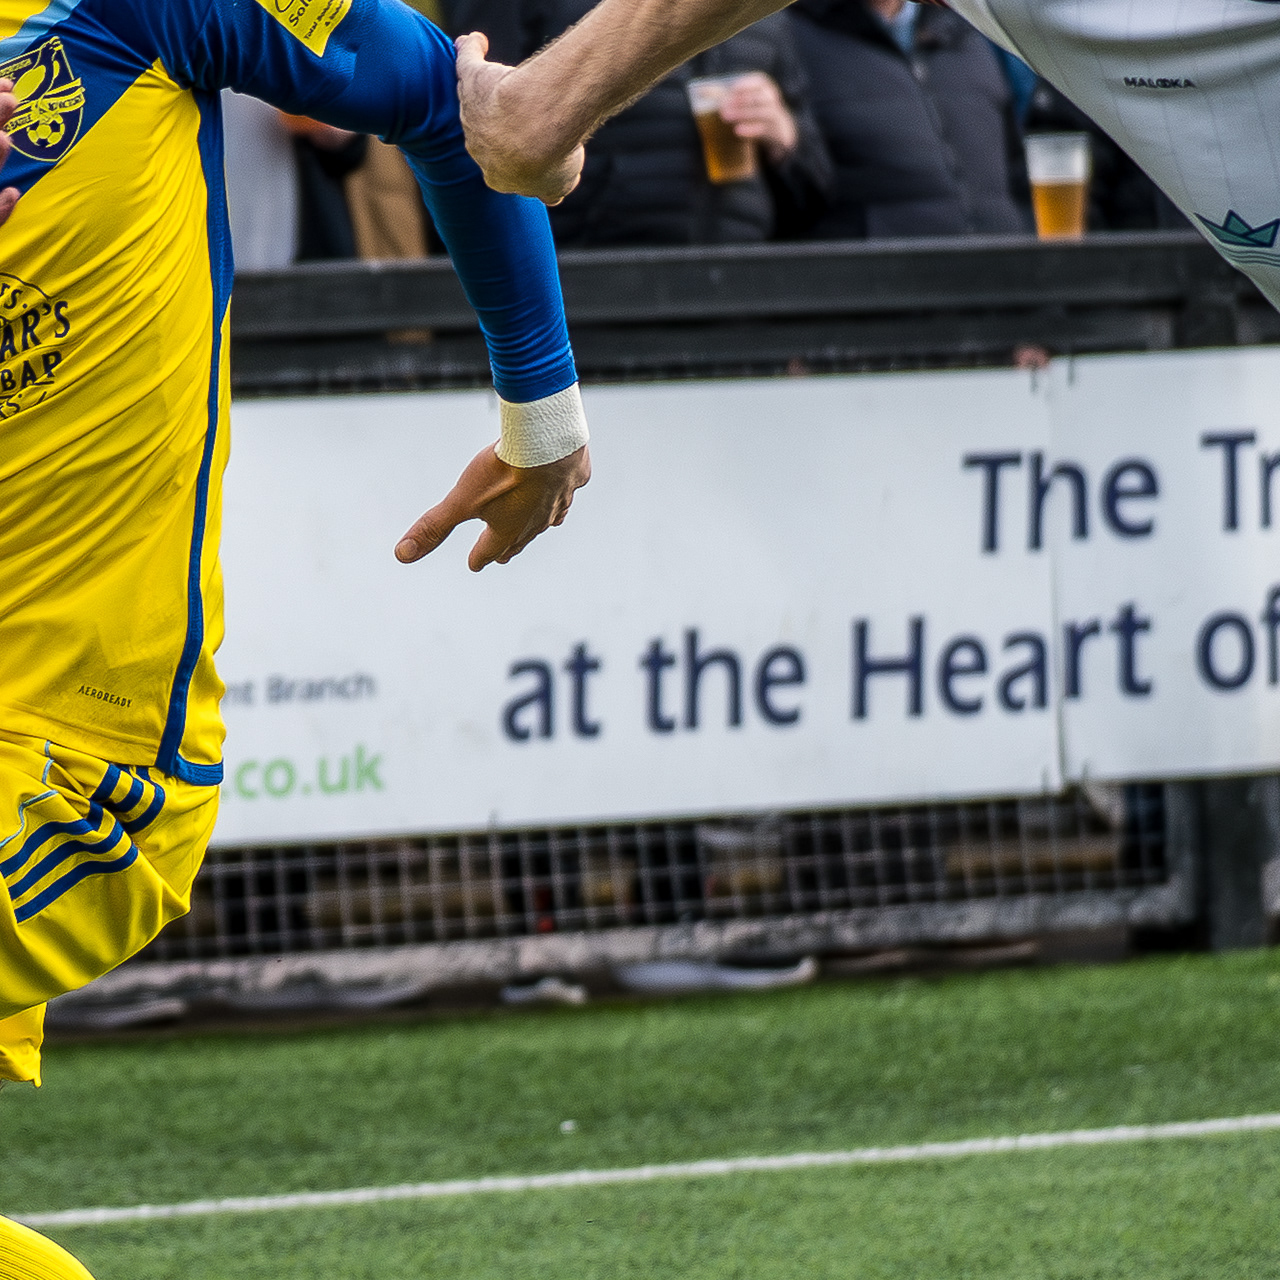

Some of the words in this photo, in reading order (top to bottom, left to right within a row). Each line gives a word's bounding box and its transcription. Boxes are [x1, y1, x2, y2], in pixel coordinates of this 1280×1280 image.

[963, 451, 1160, 554] The
[502, 642, 602, 744] at
[640, 628, 808, 735] the
[851, 602, 1154, 721] Heart
